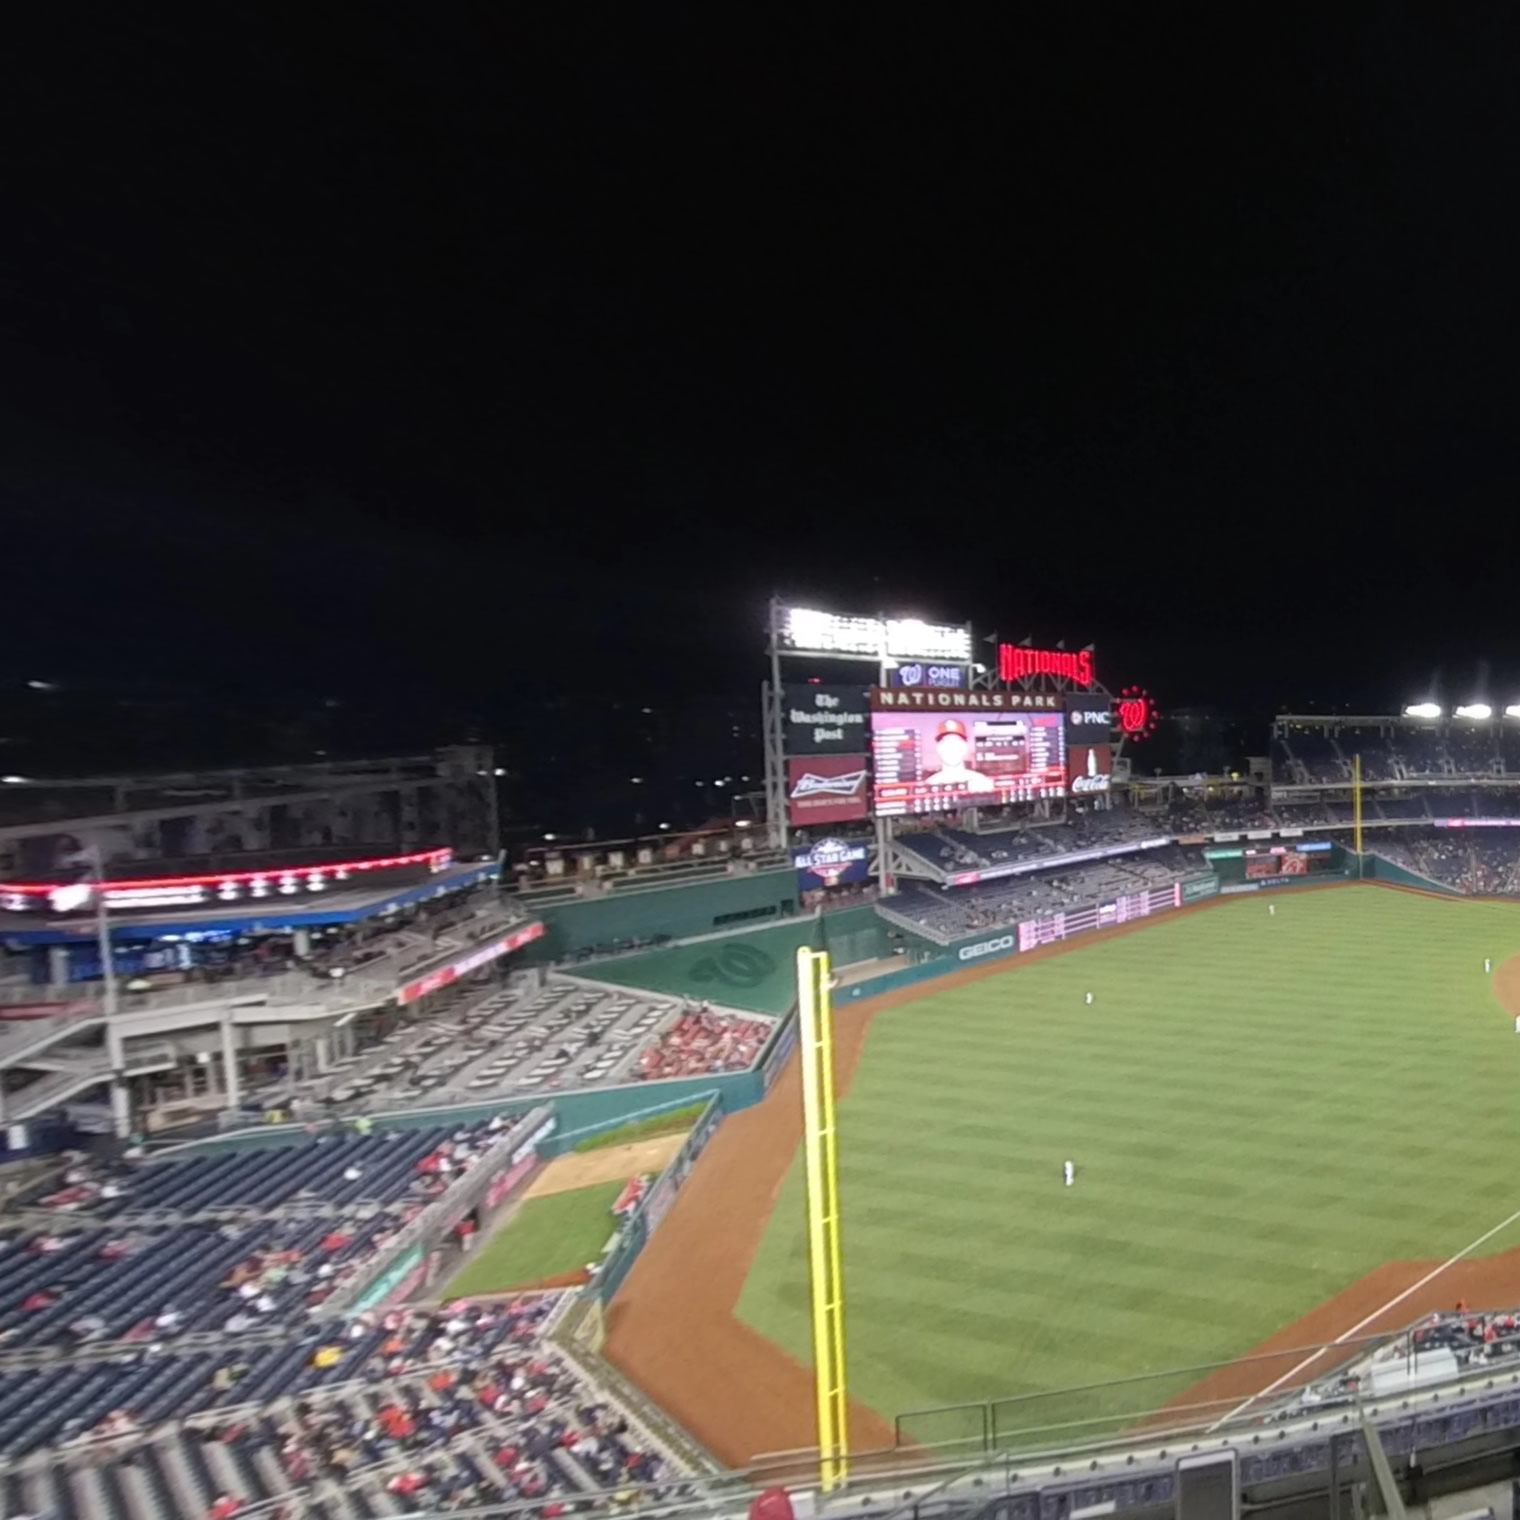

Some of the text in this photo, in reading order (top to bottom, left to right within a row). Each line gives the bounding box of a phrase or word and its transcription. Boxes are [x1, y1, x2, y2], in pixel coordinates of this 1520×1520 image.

[1000, 643, 1092, 687] NATIONALS
[928, 667, 960, 680] ONE
[815, 694, 840, 707] The
[879, 691, 1056, 707] NATIONALS PARK
[790, 708, 864, 726] Washington
[1084, 711, 1110, 724] PNC
[813, 727, 844, 743] Post
[813, 851, 839, 866] STAR
[958, 935, 1013, 960] GEICO
